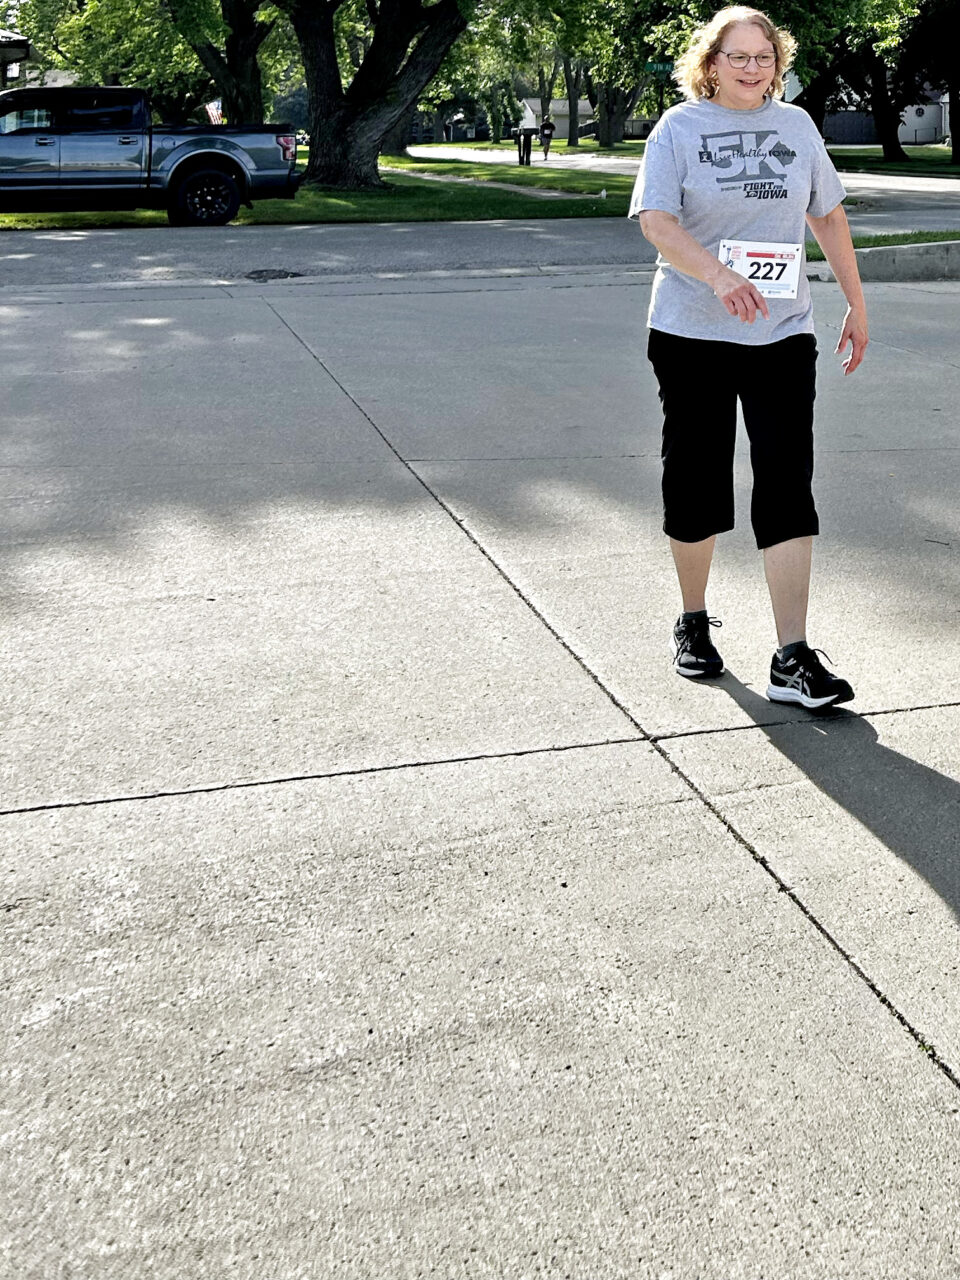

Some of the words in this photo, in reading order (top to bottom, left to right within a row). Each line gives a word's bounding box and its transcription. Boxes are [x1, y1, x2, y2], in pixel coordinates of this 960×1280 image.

[706, 132, 787, 179] 5K
[743, 182, 775, 191] FIGHT
[757, 189, 788, 200] IOWA
[748, 261, 788, 281] 227
